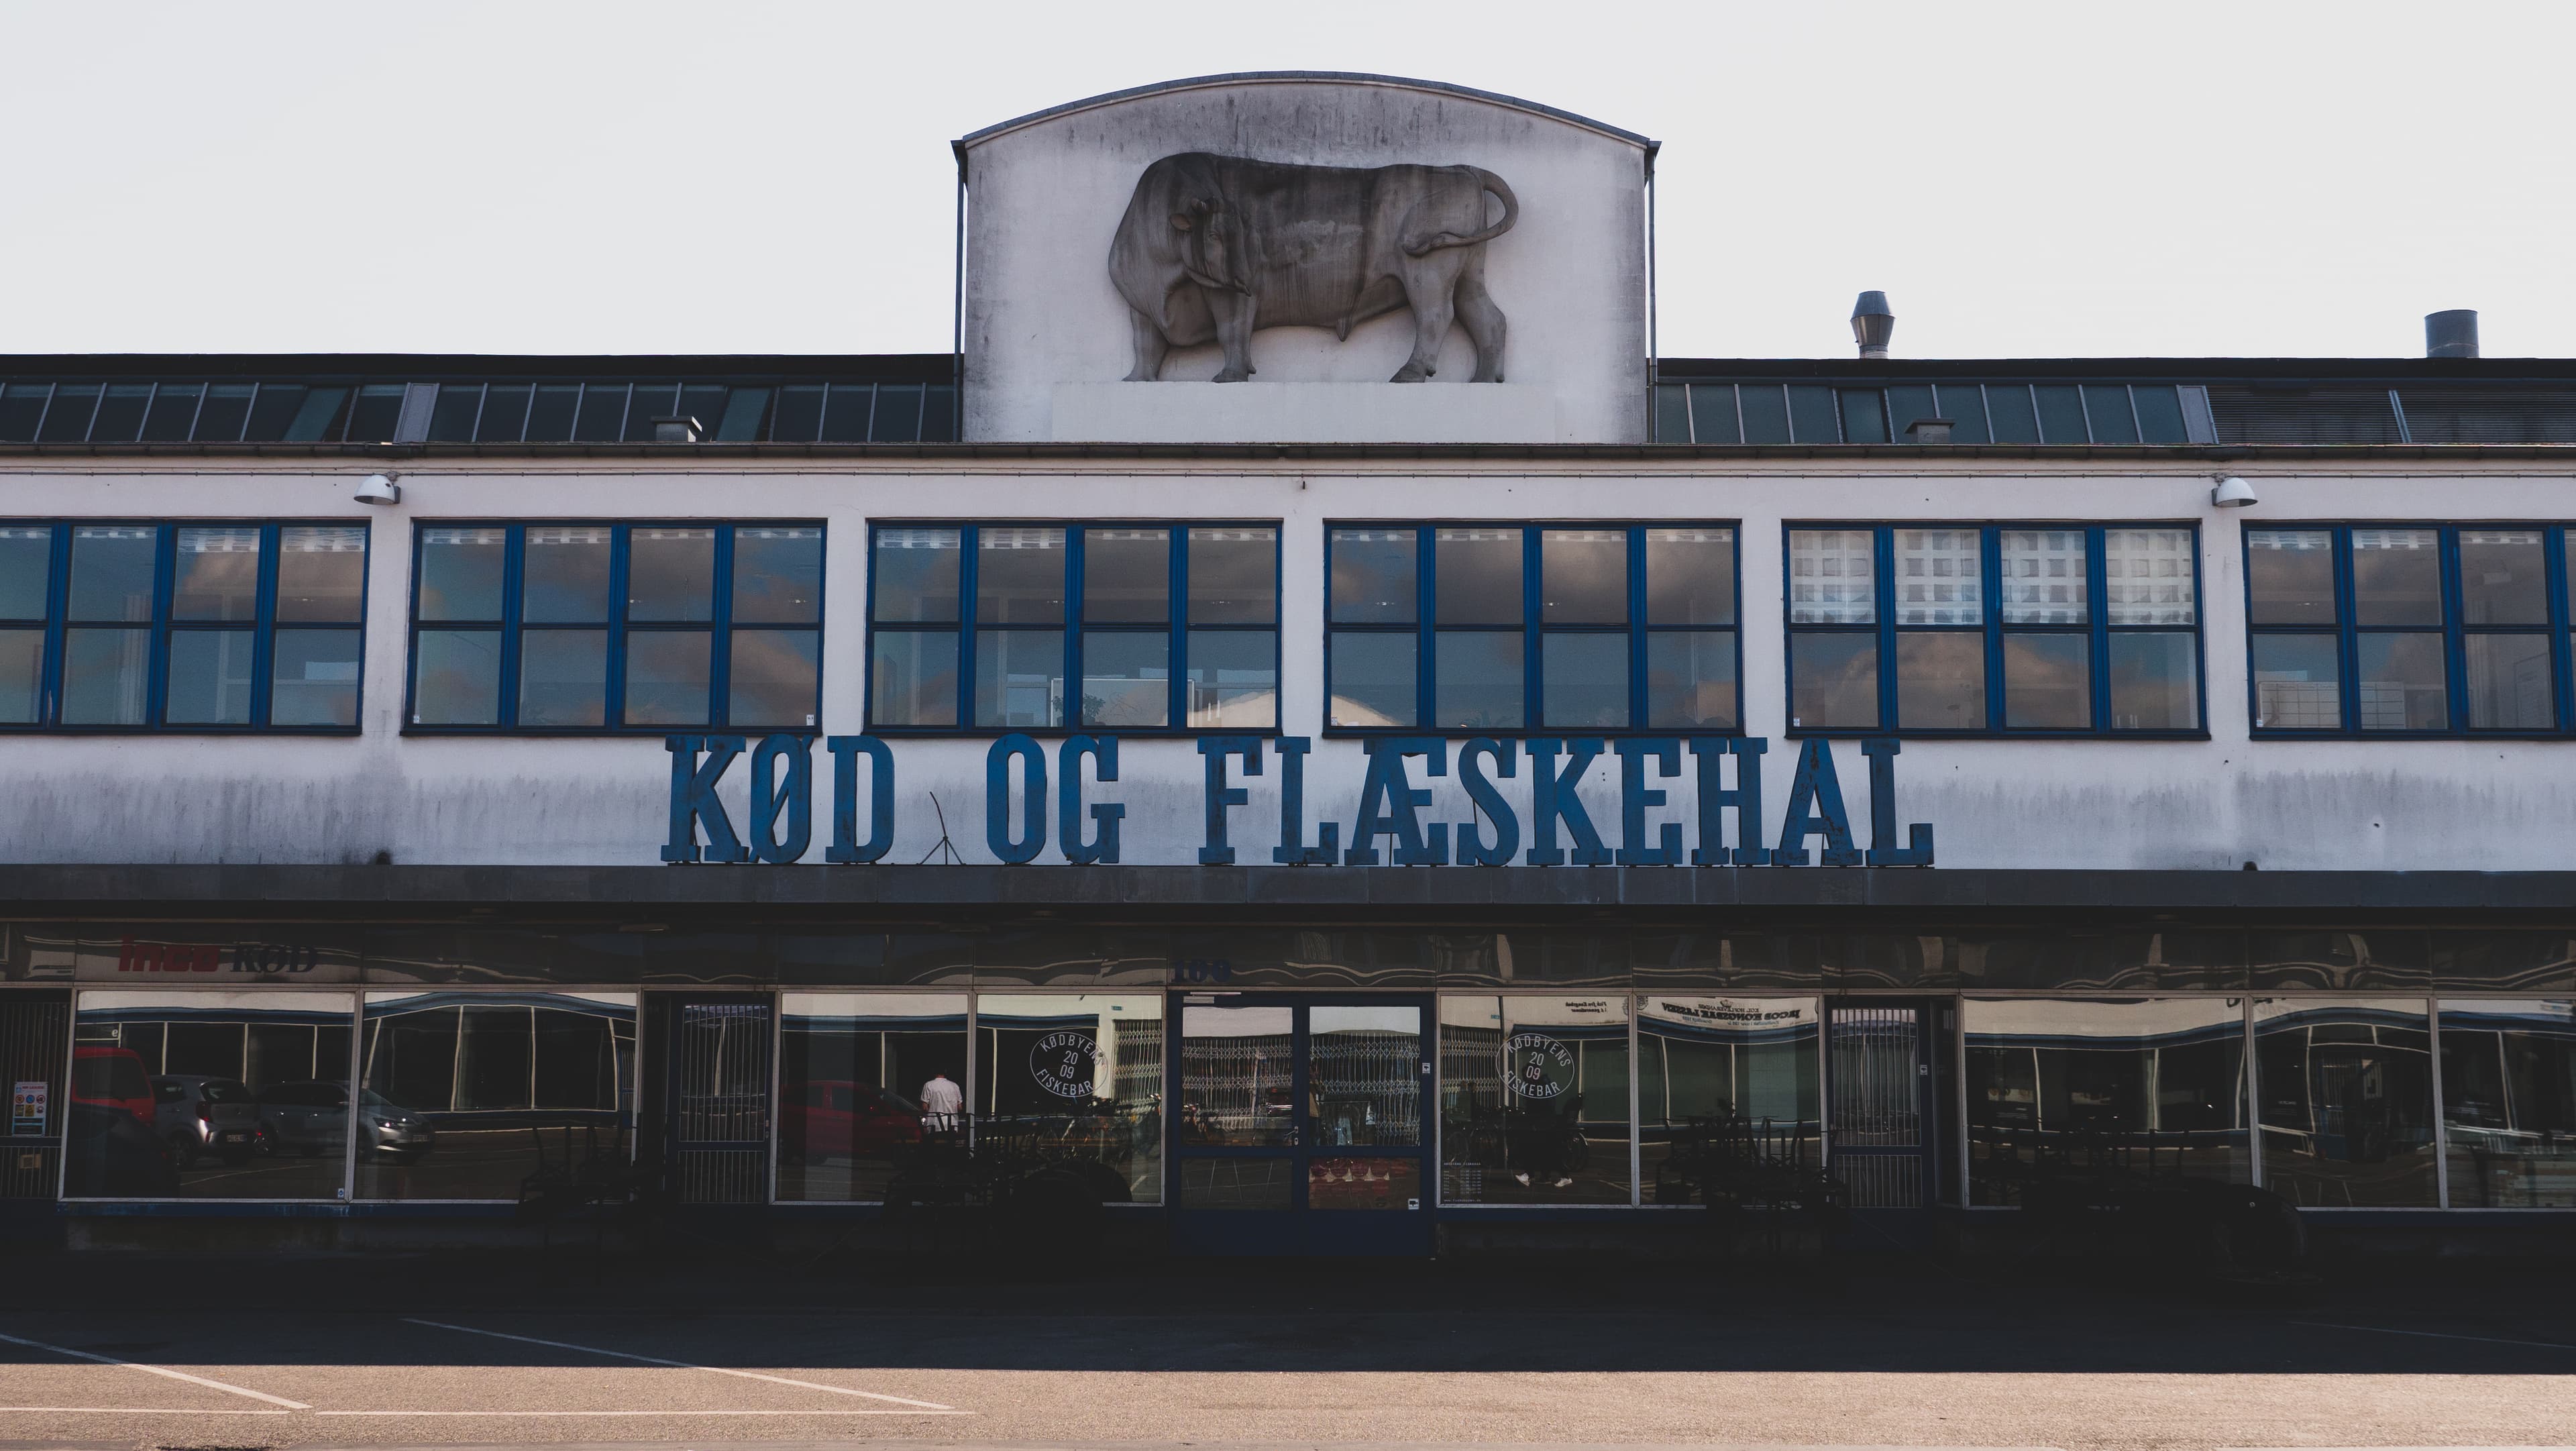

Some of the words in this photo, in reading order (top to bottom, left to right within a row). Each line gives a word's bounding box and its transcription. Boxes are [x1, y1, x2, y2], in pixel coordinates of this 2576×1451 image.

[661, 734, 896, 865] KØD
[986, 733, 1125, 865] OG
[1197, 735, 1935, 867] FLÆSKEHAL
[229, 944, 318, 973] KØD
[1169, 959, 1231, 983] 100
[1040, 1034, 1106, 1066] KØDBYENS
[1063, 1050, 1079, 1065] 20
[1505, 1035, 1571, 1067] KØDBYENS
[1529, 1051, 1545, 1067] 20
[1036, 1068, 1094, 1095] FISKEBAR
[1059, 1064, 1075, 1079] 09
[1503, 1069, 1561, 1097] FISKEBAR
[1525, 1065, 1541, 1081] 09
